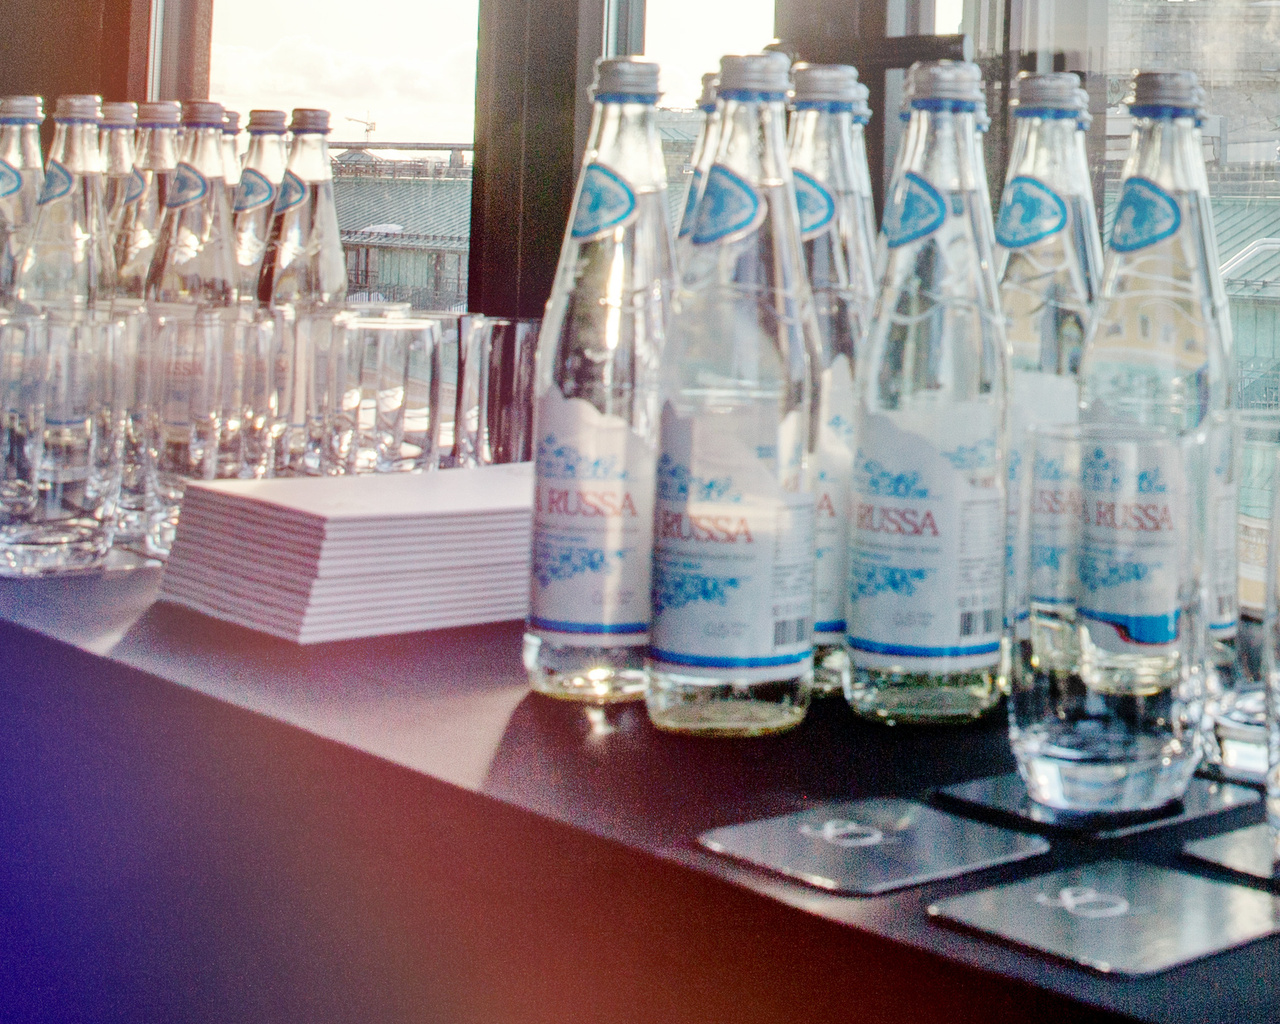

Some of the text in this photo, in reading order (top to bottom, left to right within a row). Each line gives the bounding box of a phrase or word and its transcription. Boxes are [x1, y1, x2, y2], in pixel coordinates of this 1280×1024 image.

[547, 487, 638, 517] RUSSA
[1095, 500, 1175, 532] RUSSA
[660, 509, 754, 544] RUSSA
[856, 502, 941, 537] RUSSA
